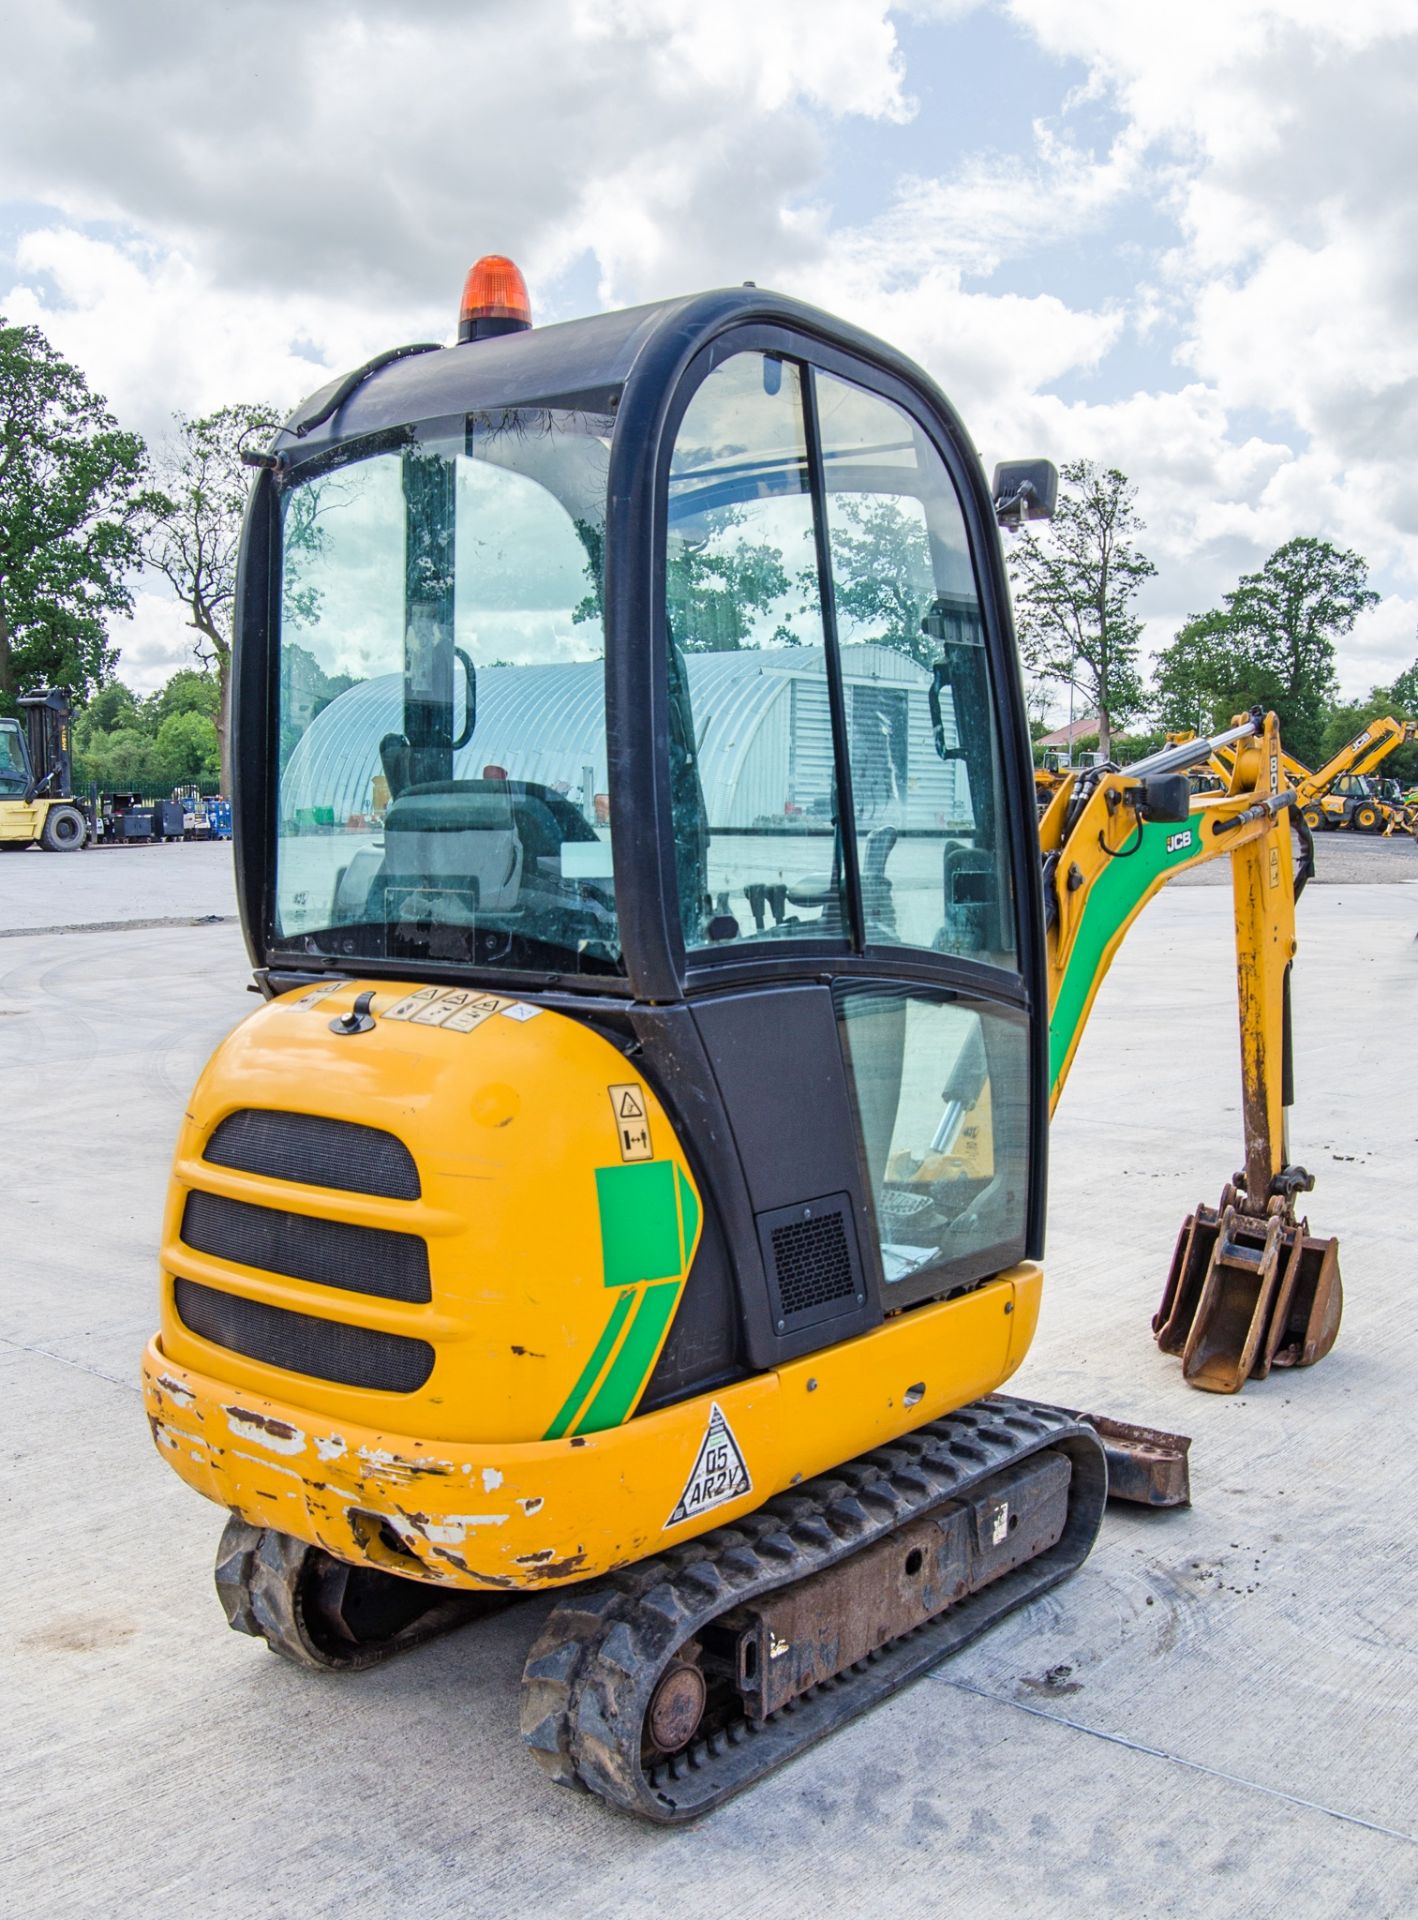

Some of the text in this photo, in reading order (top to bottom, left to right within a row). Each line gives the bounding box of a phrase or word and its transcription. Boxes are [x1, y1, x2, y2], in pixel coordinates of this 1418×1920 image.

[1351, 732, 1371, 752] JCB
[1166, 831, 1192, 853] JCB
[689, 1465, 739, 1508] AR2Y
